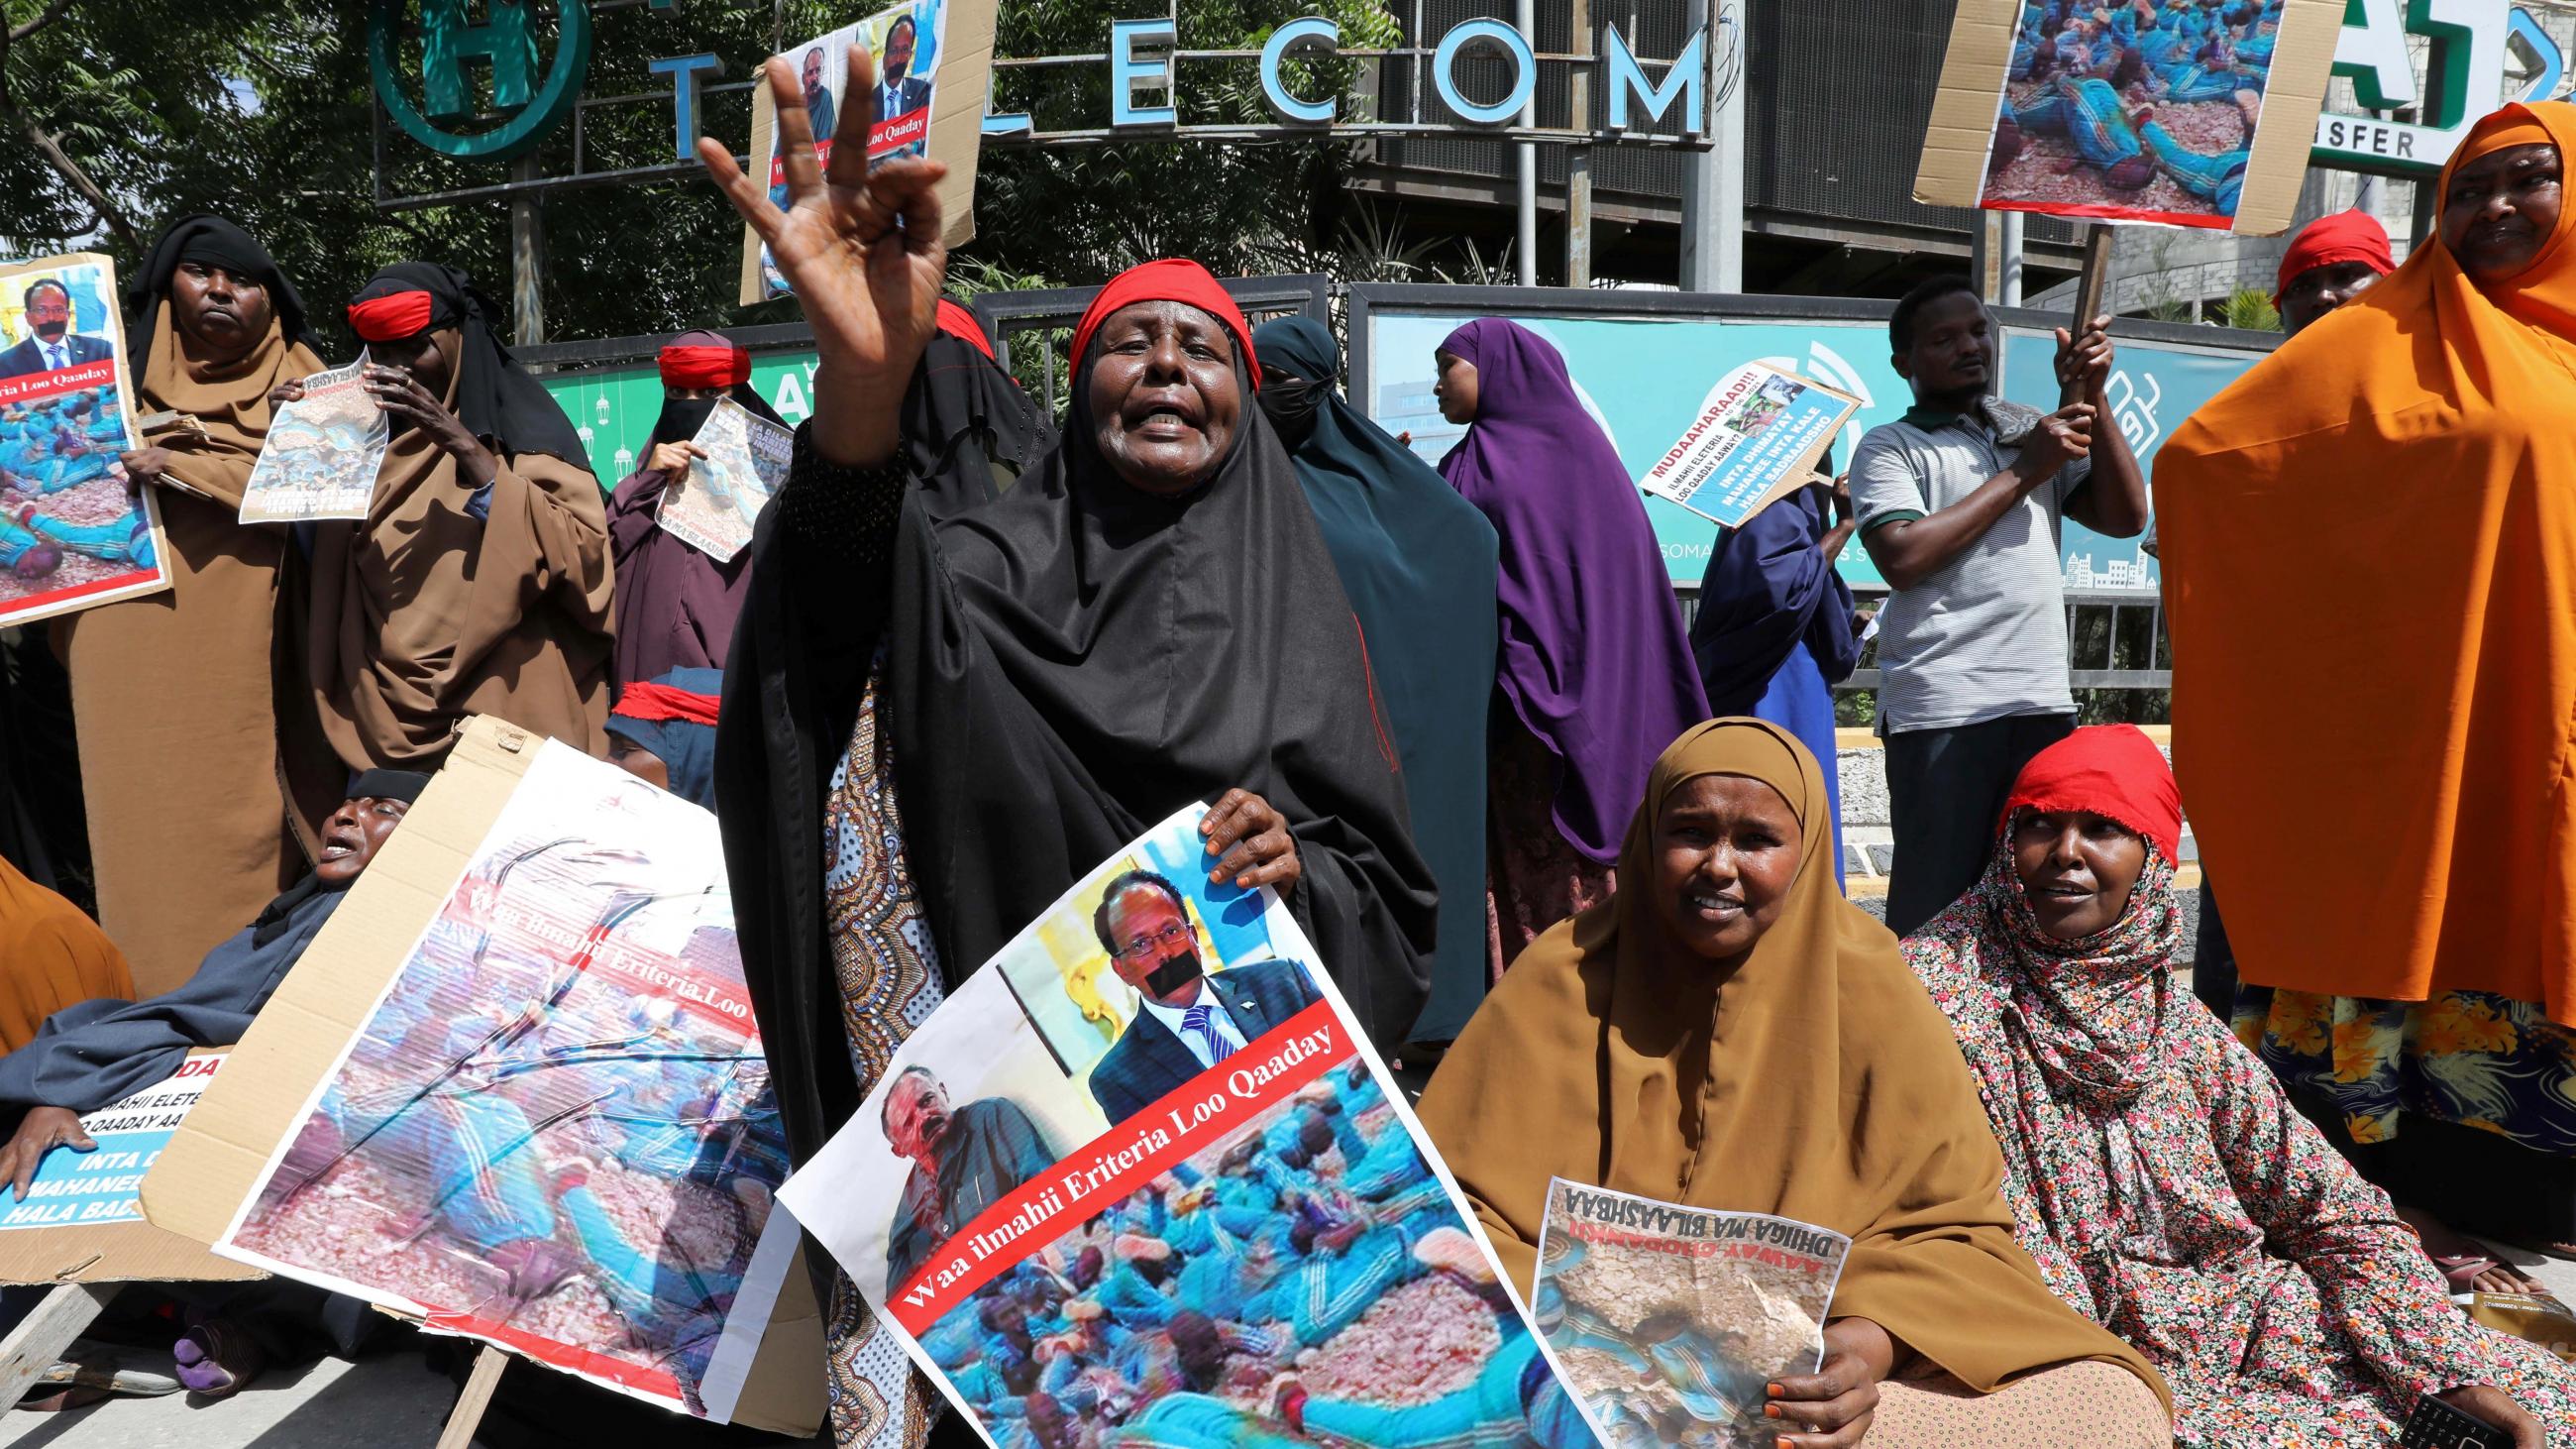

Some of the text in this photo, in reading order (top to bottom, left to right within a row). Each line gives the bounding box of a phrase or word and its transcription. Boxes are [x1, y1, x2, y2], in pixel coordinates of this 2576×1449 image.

[885, 118, 924, 142] Qaaday
[2312, 120, 2415, 159] SFER
[0, 368, 110, 397] ria Loo Qaaday
[1652, 372, 1758, 479] MUDAAHARAAD!!!
[1767, 433, 1796, 458] INTA
[1790, 406, 1822, 434] KALE
[1691, 435, 1725, 466] ELETERIA
[1674, 434, 1742, 502] LOO QAADAY AAWAY?
[1719, 463, 1747, 489] INTA
[1738, 482, 1770, 509] HALA
[1661, 543, 1711, 559] SOMA
[608, 947, 703, 1001] Eriteria
[702, 985, 747, 1019] Loo
[175, 1059, 220, 1078] DA
[152, 1092, 202, 1108] ELETE
[91, 1115, 160, 1132] QAADAY
[157, 1113, 184, 1128] AA
[76, 1151, 140, 1171] INTA
[903, 1025, 1332, 1308] Waa ilmahii Eriteria Loo Qaaday
[1, 1202, 78, 1224] HALA
[1565, 1188, 1833, 1258] DHIIGA MA BILAASHBAA
[1724, 1243, 1823, 1274] AAWAY
